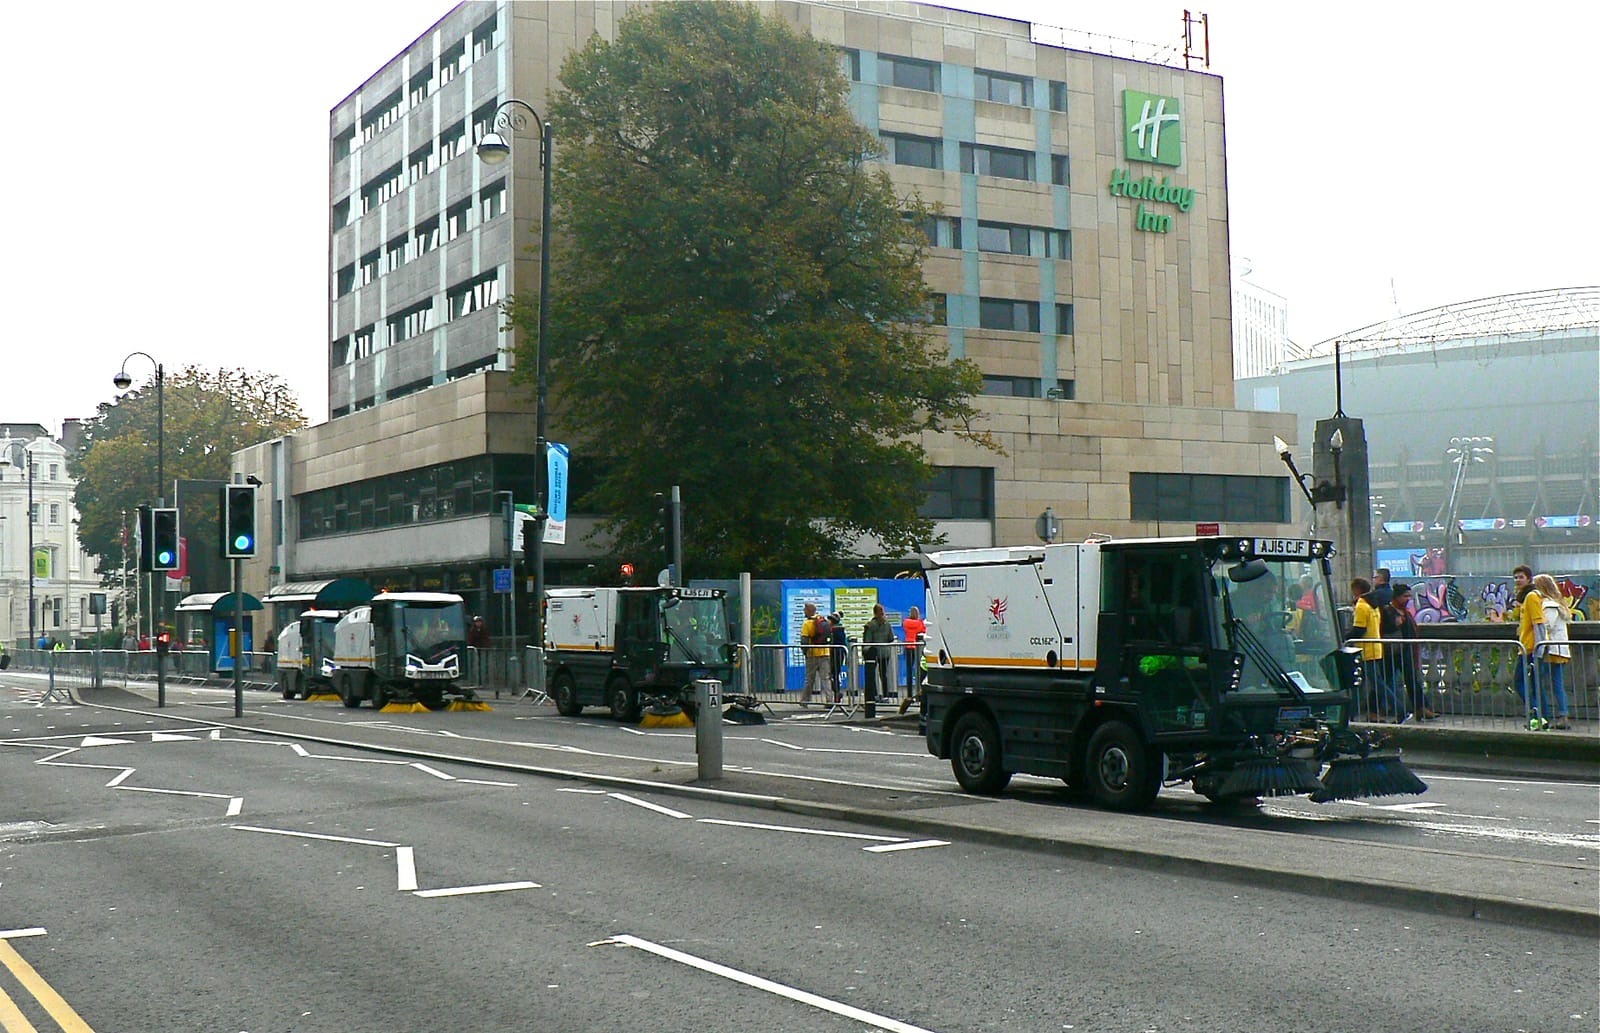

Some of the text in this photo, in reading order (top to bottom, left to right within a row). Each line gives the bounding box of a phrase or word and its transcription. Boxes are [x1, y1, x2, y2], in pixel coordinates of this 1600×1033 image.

[1110, 168, 1195, 213] Holiday
[1137, 203, 1172, 233] Inn
[1261, 540, 1304, 554] AJ15 CJF
